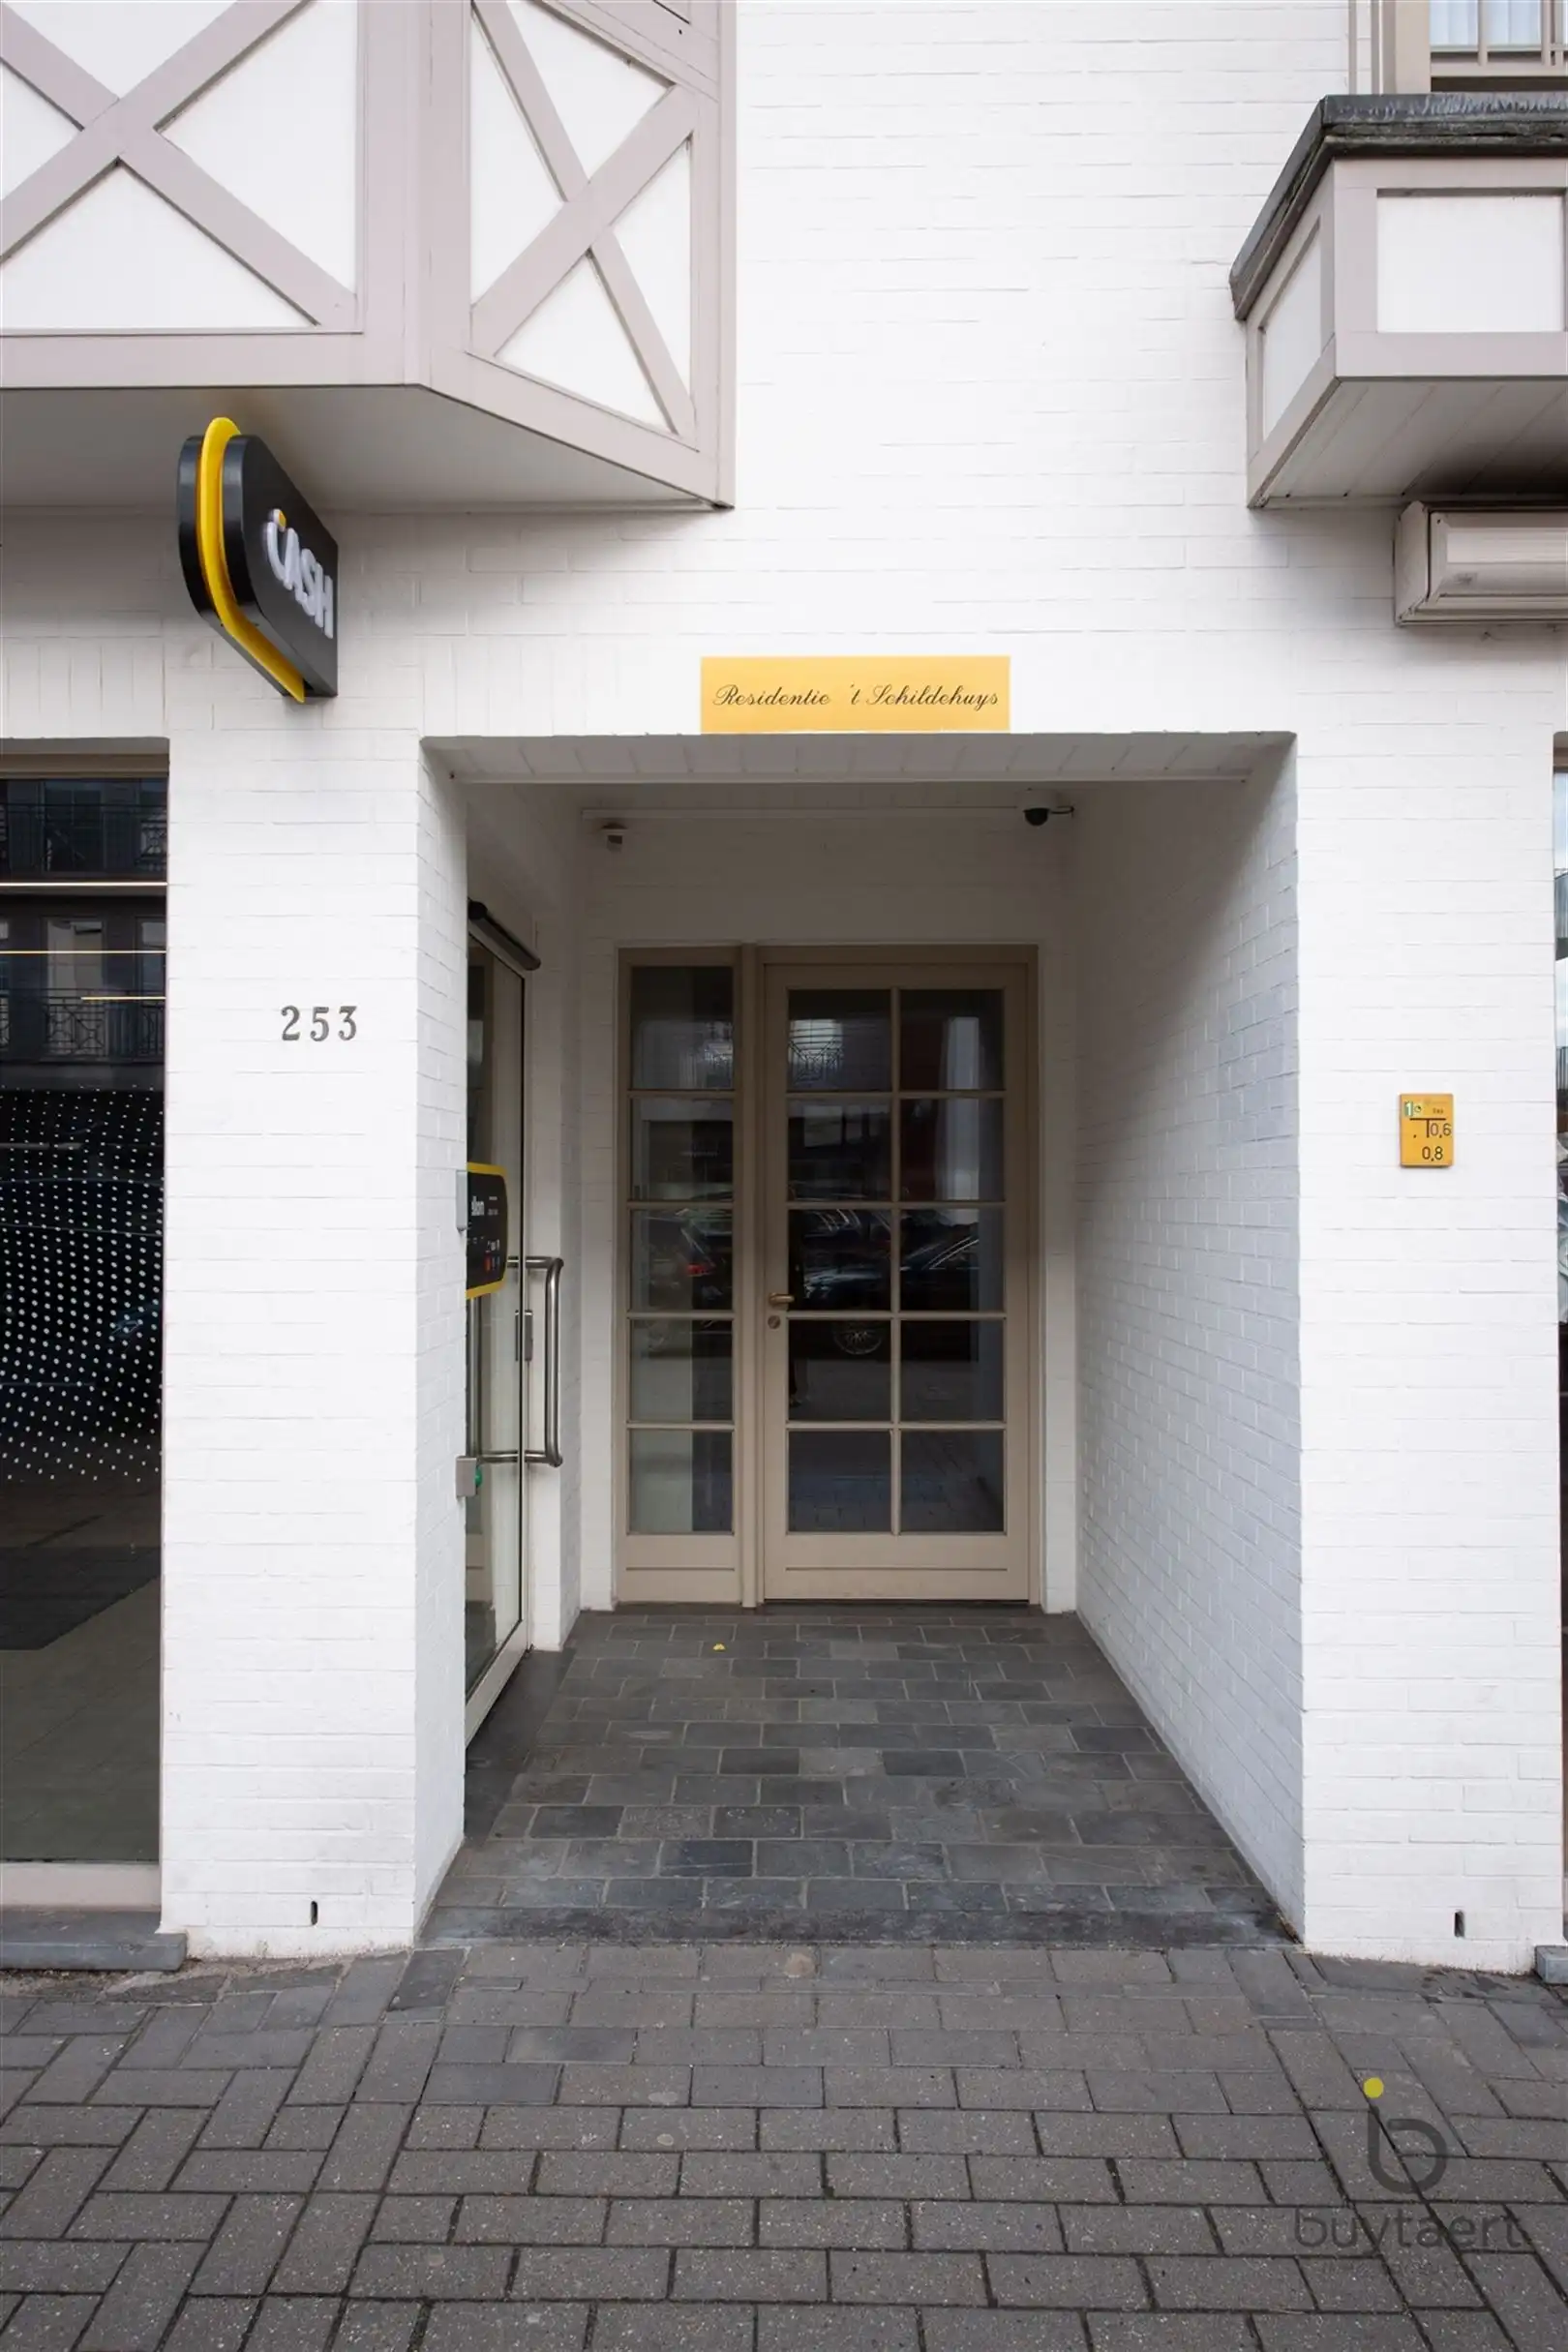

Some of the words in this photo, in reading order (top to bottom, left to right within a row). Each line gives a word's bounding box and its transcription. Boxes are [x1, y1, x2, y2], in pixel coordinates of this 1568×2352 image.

[267, 509, 333, 639] CASH
[712, 684, 830, 706] Residentie
[849, 682, 861, 706] 't
[866, 683, 998, 711] Schildehuys
[281, 1005, 357, 1041] 253
[1422, 1146, 1443, 1161] 0,8
